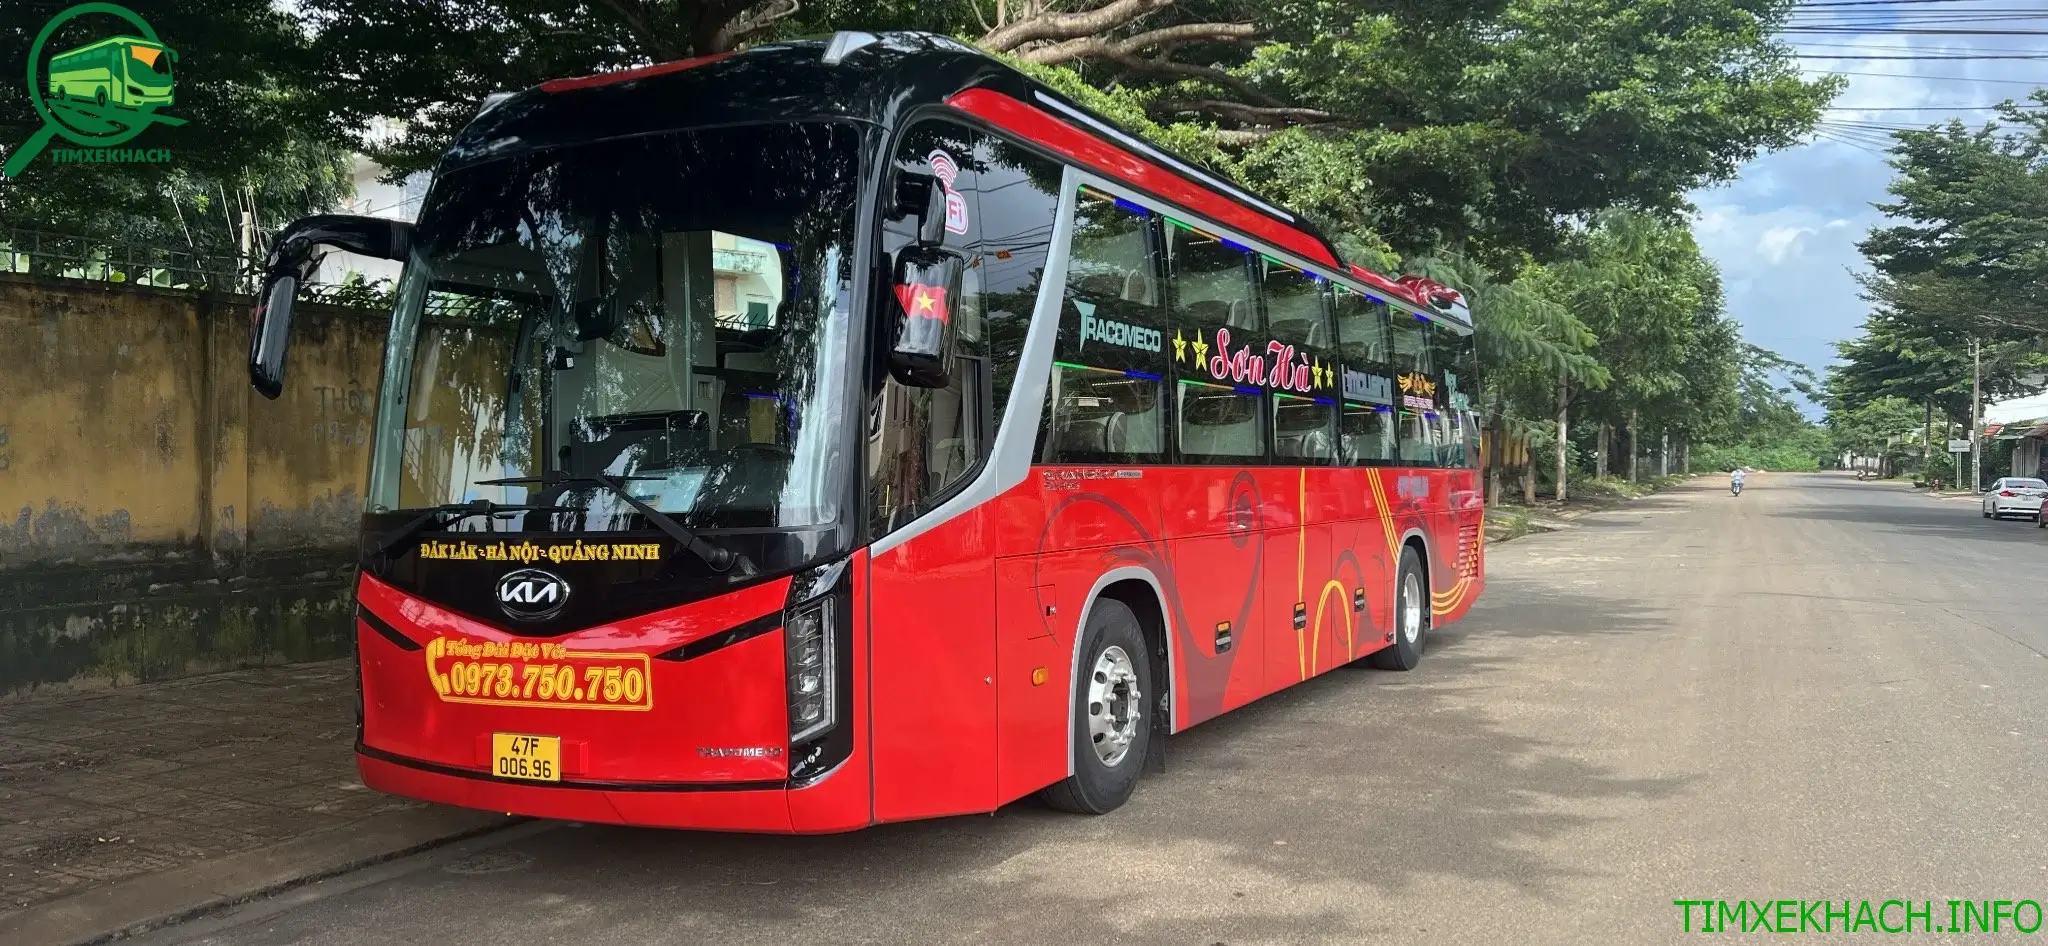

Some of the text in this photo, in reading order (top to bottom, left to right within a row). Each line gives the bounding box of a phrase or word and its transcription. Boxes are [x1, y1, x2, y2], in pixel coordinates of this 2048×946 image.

[1071, 298, 1161, 353] TRACOMECO
[1210, 328, 1312, 393] Sơn Hà
[548, 539, 609, 564] QUẢNG
[611, 544, 660, 560] NINH
[451, 661, 644, 702] 0973.750.750
[511, 737, 539, 756] 47F
[500, 757, 551, 778] 006.96
